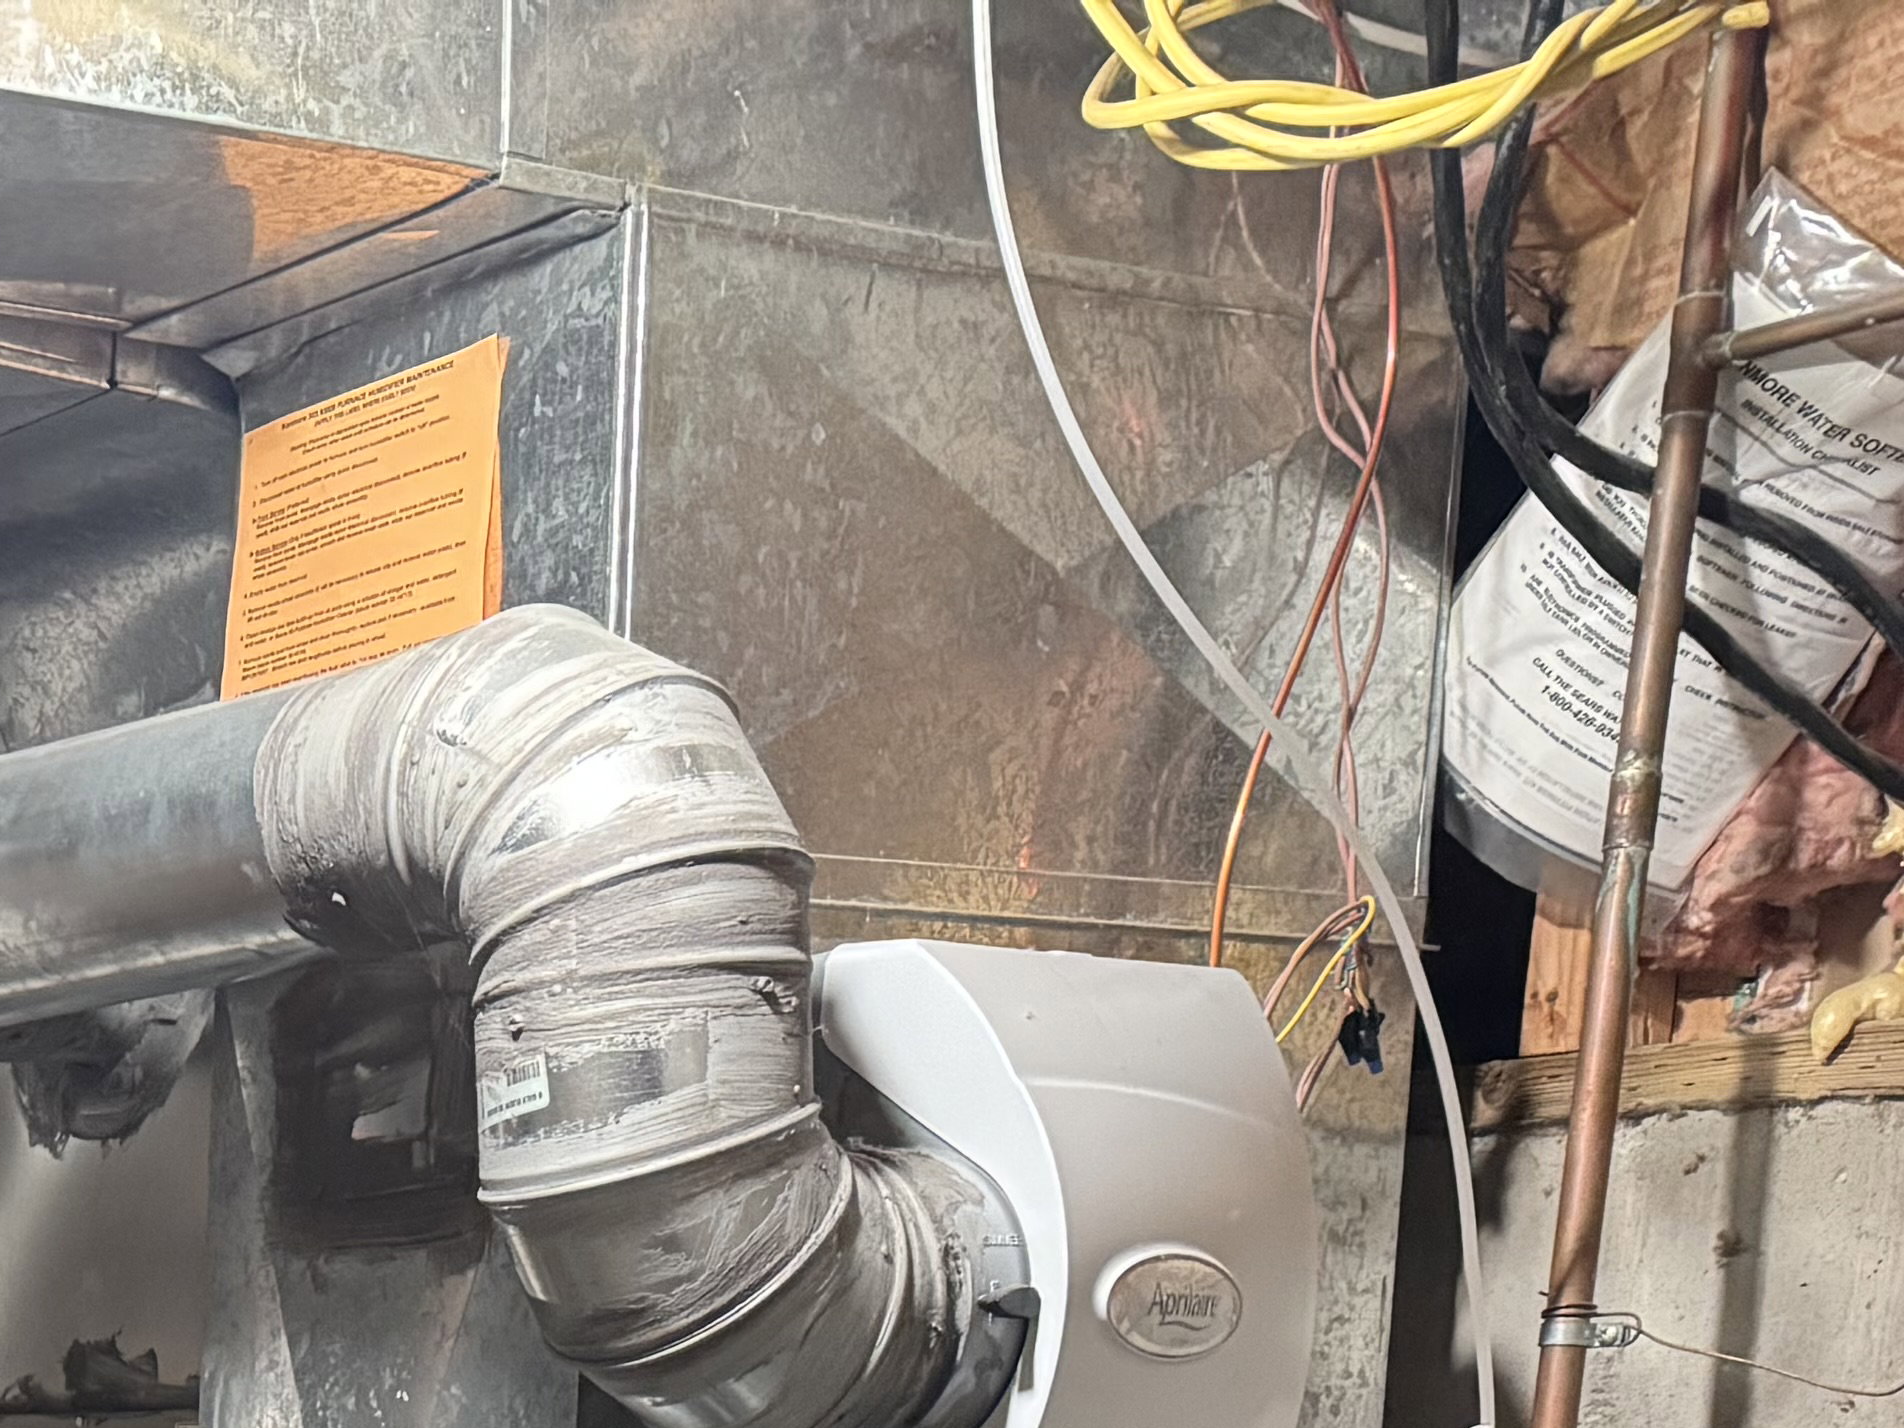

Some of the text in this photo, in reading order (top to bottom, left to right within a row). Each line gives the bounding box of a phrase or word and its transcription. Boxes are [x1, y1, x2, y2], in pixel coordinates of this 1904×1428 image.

[406, 360, 455, 384] MAINTENANCE
[1740, 360, 1904, 463] NMORE WATER SOFTE
[1741, 399, 1814, 454] INSTALLATION
[1763, 482, 1801, 508] REMOVED
[1532, 657, 1554, 680] CALL
[1554, 676, 1572, 693] THE
[1571, 687, 1604, 712] SEARS
[1541, 685, 1622, 744] 1-800-426-934
[1147, 1282, 1221, 1325] Aprilaire
